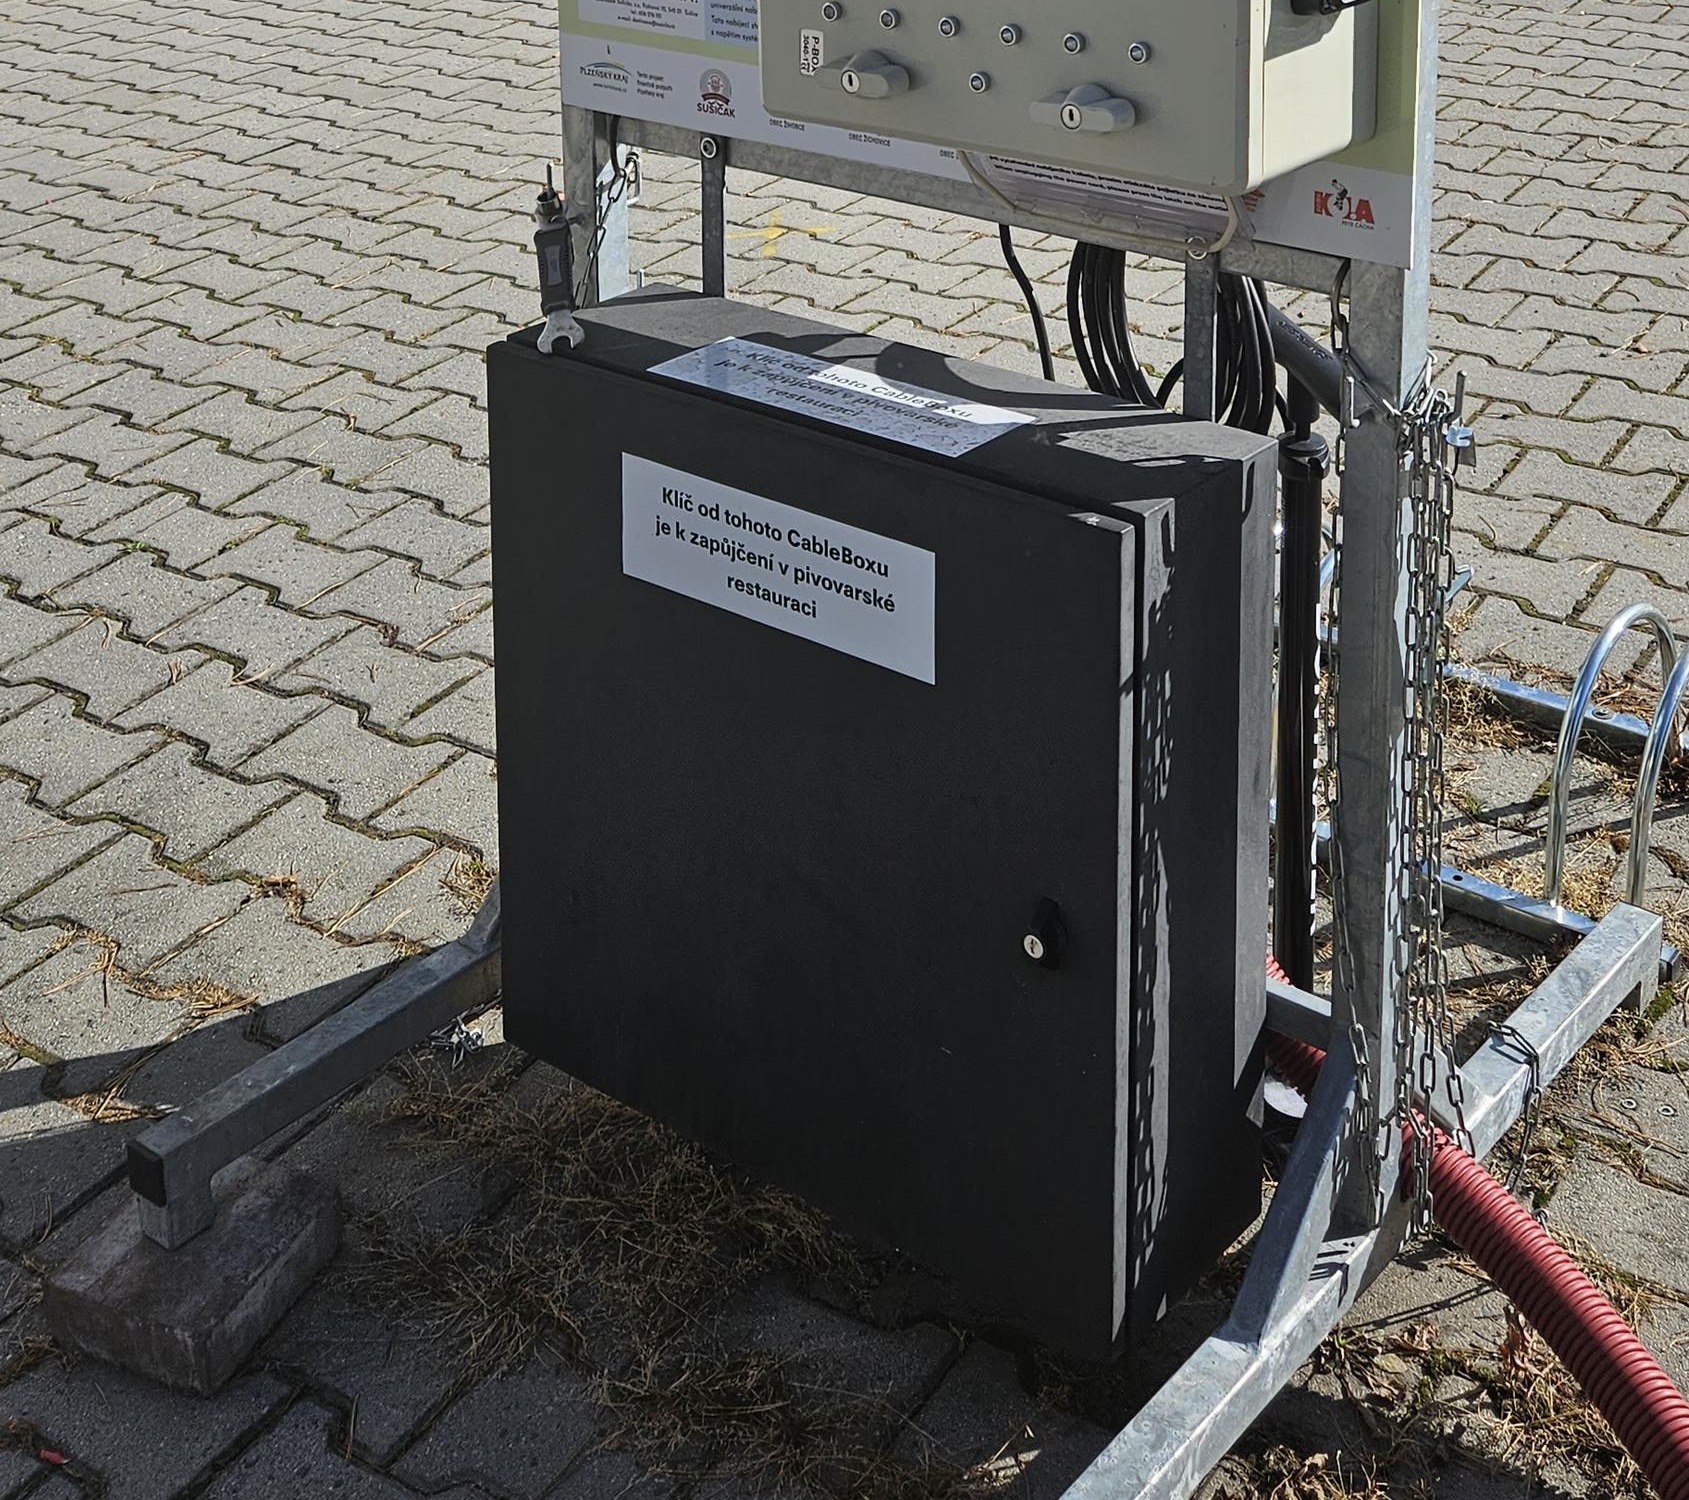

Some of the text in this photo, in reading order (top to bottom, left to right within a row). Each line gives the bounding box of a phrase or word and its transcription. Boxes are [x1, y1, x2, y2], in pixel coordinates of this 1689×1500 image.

[714, 358, 731, 369] je
[841, 390, 856, 399] v
[855, 395, 960, 429] pivovarské
[767, 386, 863, 418] restauraci
[870, 385, 973, 418] CableBoxu
[662, 487, 889, 578] Klíč od tohoto CableBoxu
[655, 516, 896, 613] je k zapůjčení v pivovarské
[727, 575, 817, 618] restauraci
